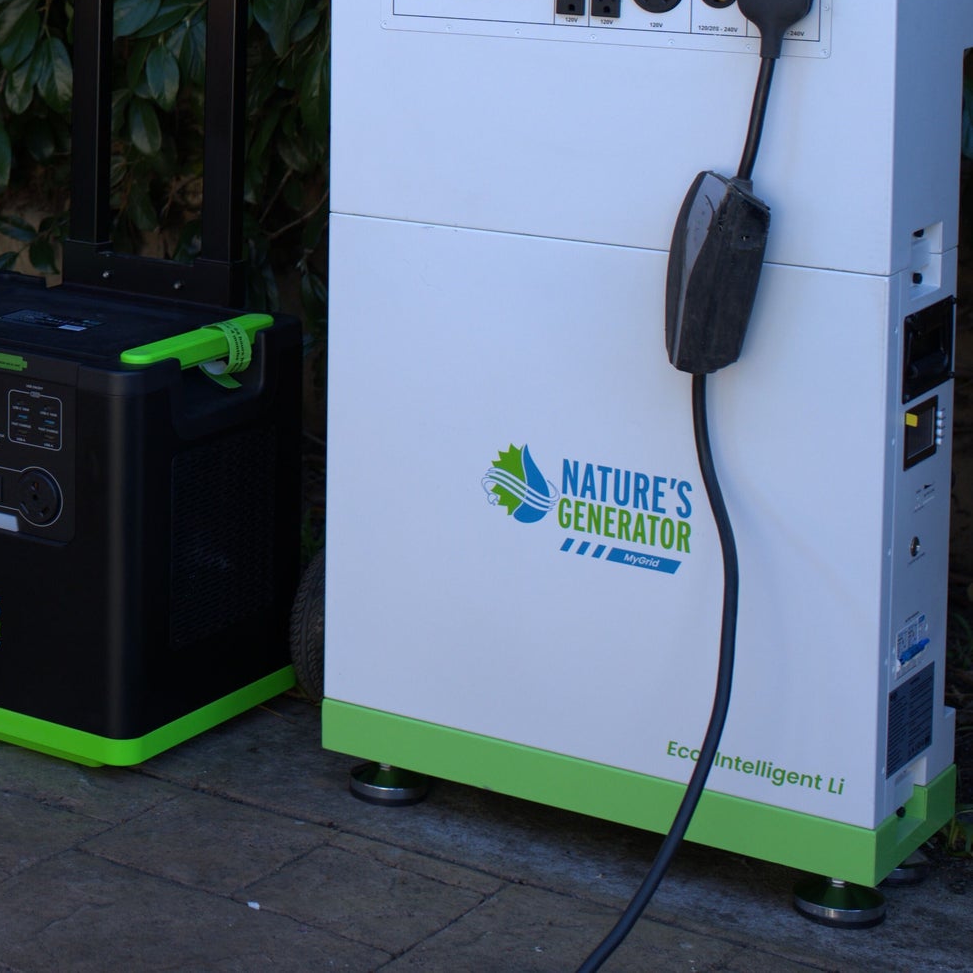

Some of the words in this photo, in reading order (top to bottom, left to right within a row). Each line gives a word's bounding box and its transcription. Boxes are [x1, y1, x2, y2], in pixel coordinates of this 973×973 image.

[562, 458, 692, 519] NATURE'S
[557, 498, 692, 554] GENERATOR
[624, 554, 660, 568] MyGrid
[828, 777, 845, 795] Li
